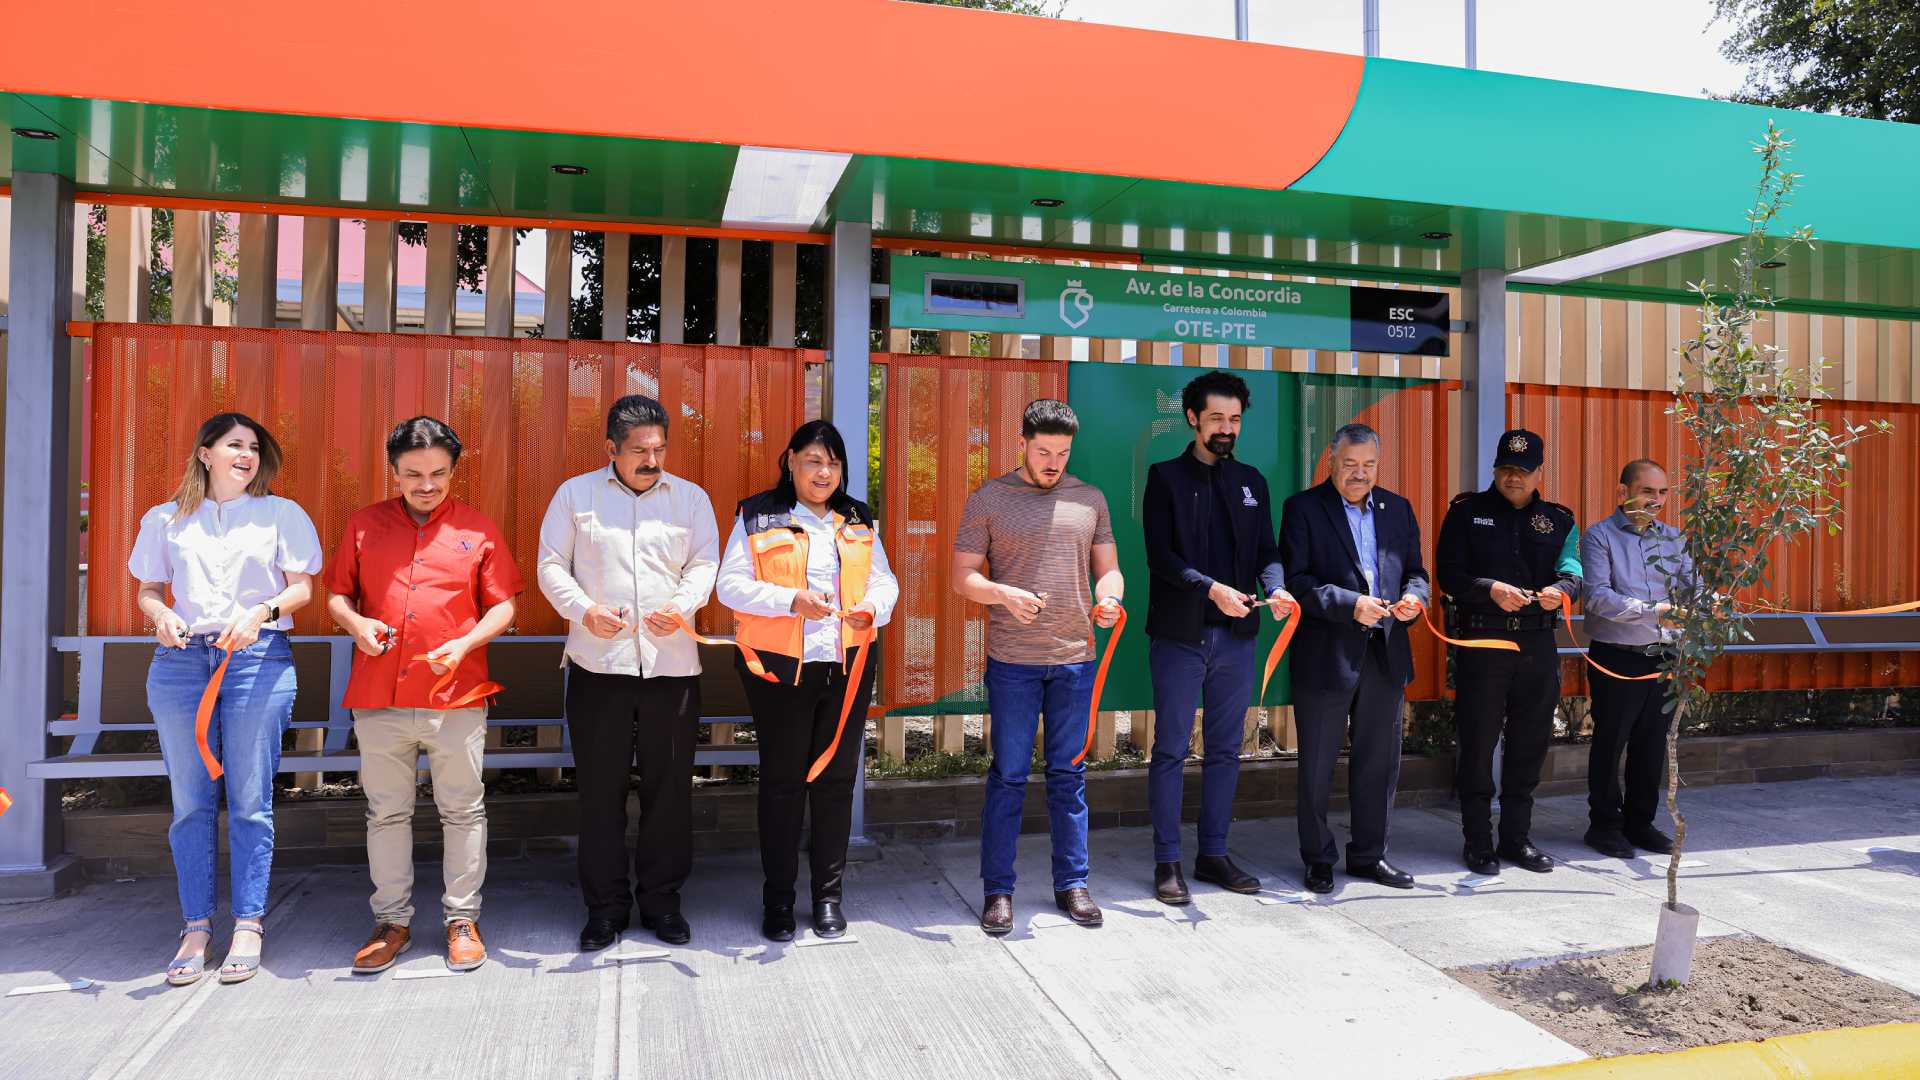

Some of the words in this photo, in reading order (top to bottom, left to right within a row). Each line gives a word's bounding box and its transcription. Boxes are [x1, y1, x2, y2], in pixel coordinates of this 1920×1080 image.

[1125, 278, 1155, 296] Av.
[1159, 280, 1184, 297] de
[1188, 281, 1204, 298] la
[1209, 283, 1302, 304] Concordia
[1163, 303, 1211, 315] Carretera
[1212, 308, 1219, 316] a
[1220, 306, 1267, 318] Colombia
[1389, 307, 1414, 321] ESC
[1174, 319, 1256, 340] OTE-PTE
[1387, 324, 1416, 339] 0512
